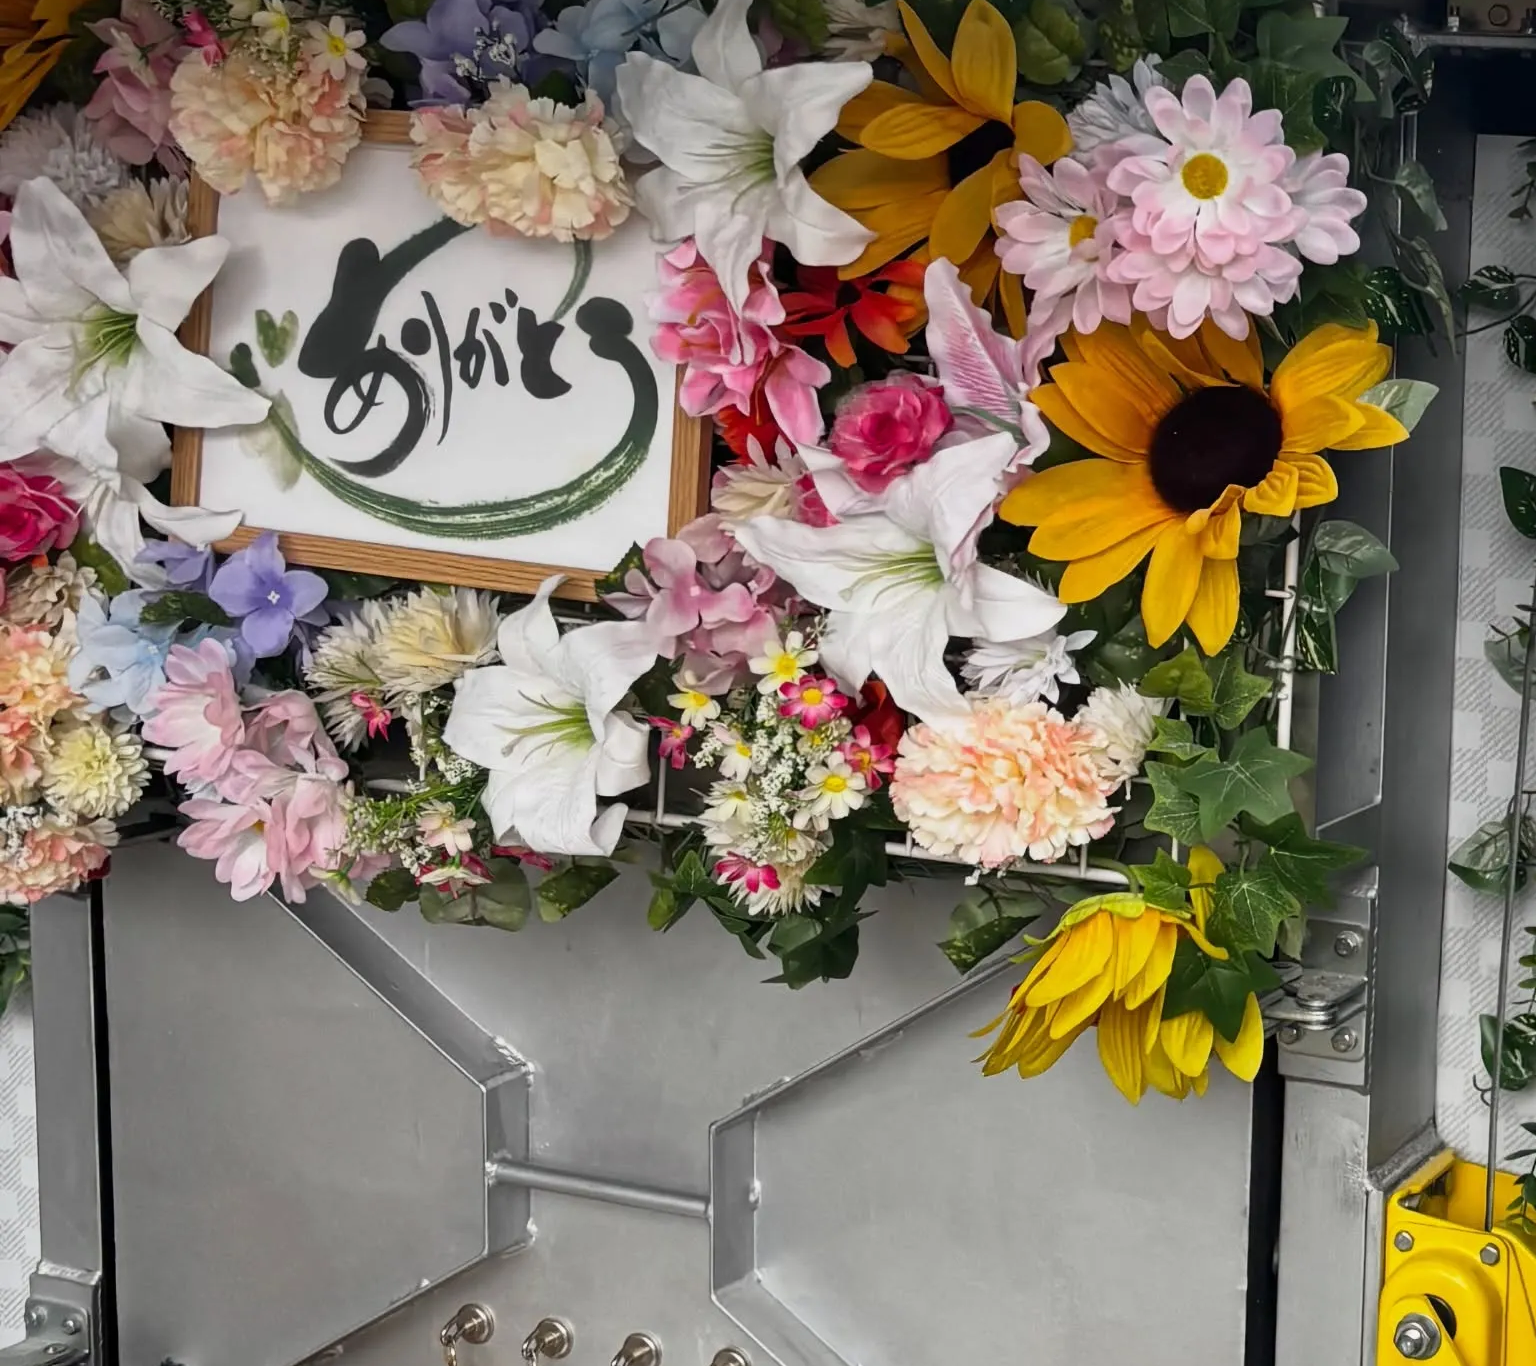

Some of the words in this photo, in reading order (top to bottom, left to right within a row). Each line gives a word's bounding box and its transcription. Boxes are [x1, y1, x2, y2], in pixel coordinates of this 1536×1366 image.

[268, 235, 659, 540] ありがとう
